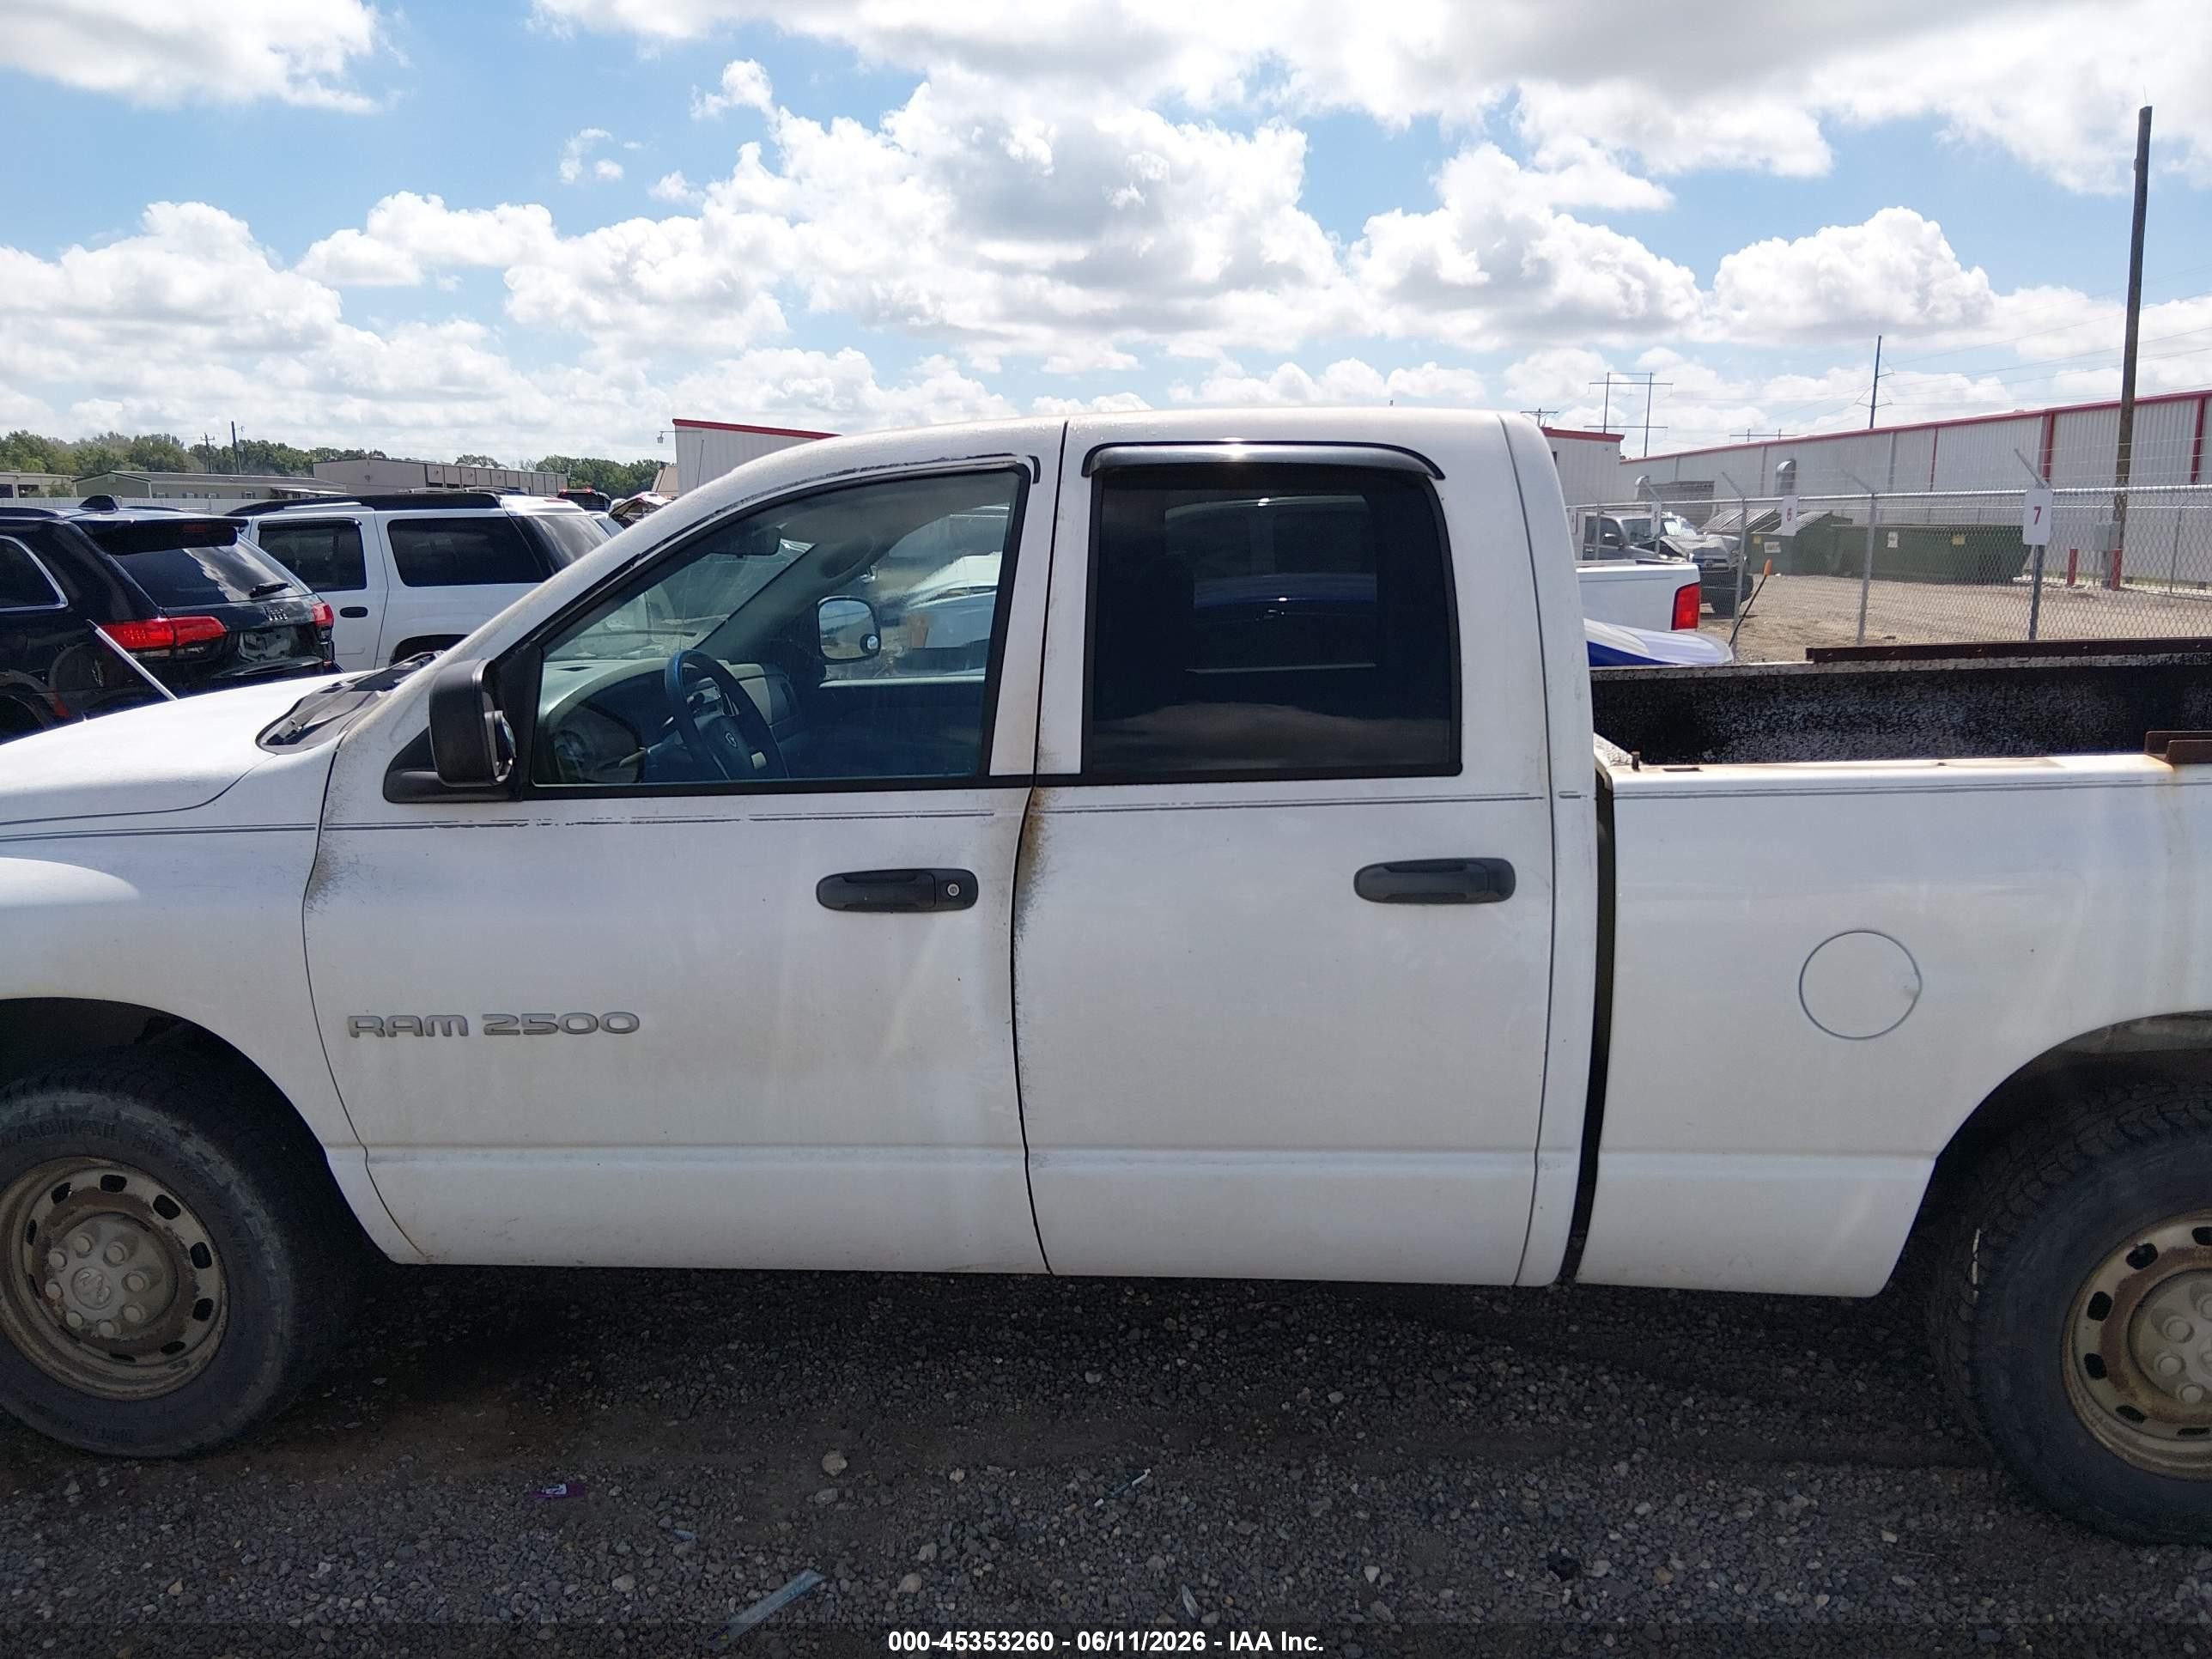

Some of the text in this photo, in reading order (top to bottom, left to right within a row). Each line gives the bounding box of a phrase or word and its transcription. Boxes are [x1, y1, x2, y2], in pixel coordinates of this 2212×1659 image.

[1786, 507, 1792, 521] 6
[2033, 506, 2042, 525] 7
[348, 1012, 641, 1038] RAM 2500
